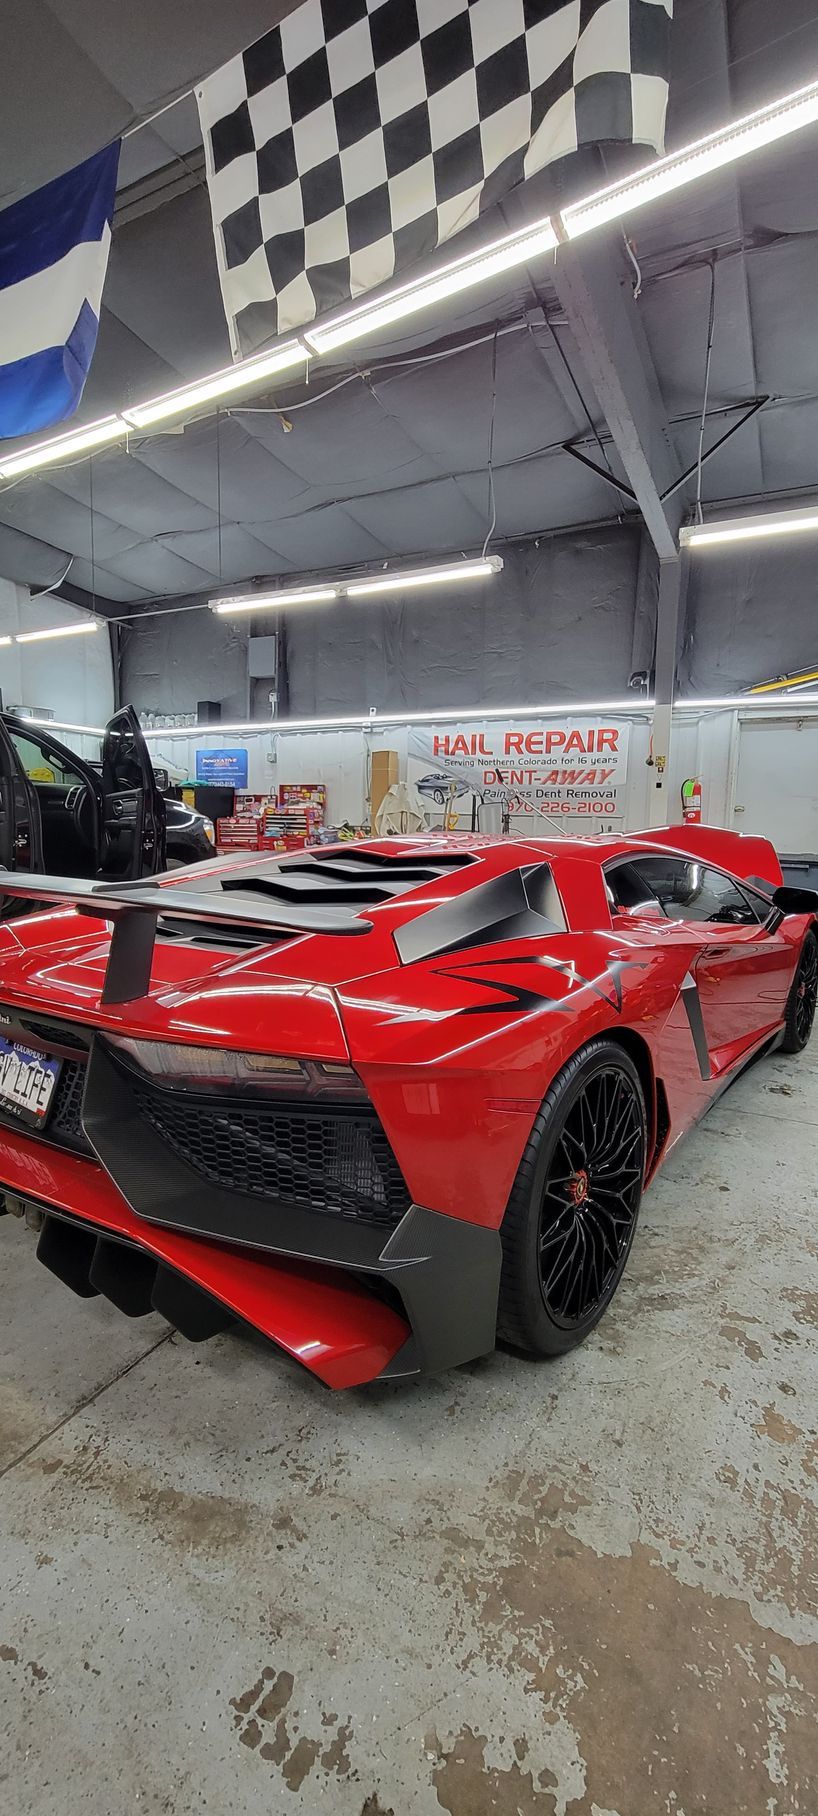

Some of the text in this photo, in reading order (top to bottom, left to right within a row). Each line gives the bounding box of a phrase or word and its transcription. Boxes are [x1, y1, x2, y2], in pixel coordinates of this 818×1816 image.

[433, 728, 619, 757] HAIL REPAIR
[444, 758, 475, 767] Serving
[477, 758, 515, 766] Northern
[518, 757, 558, 765] Colorado
[590, 757, 618, 766] years
[483, 789, 617, 798] Painss Dent Removal
